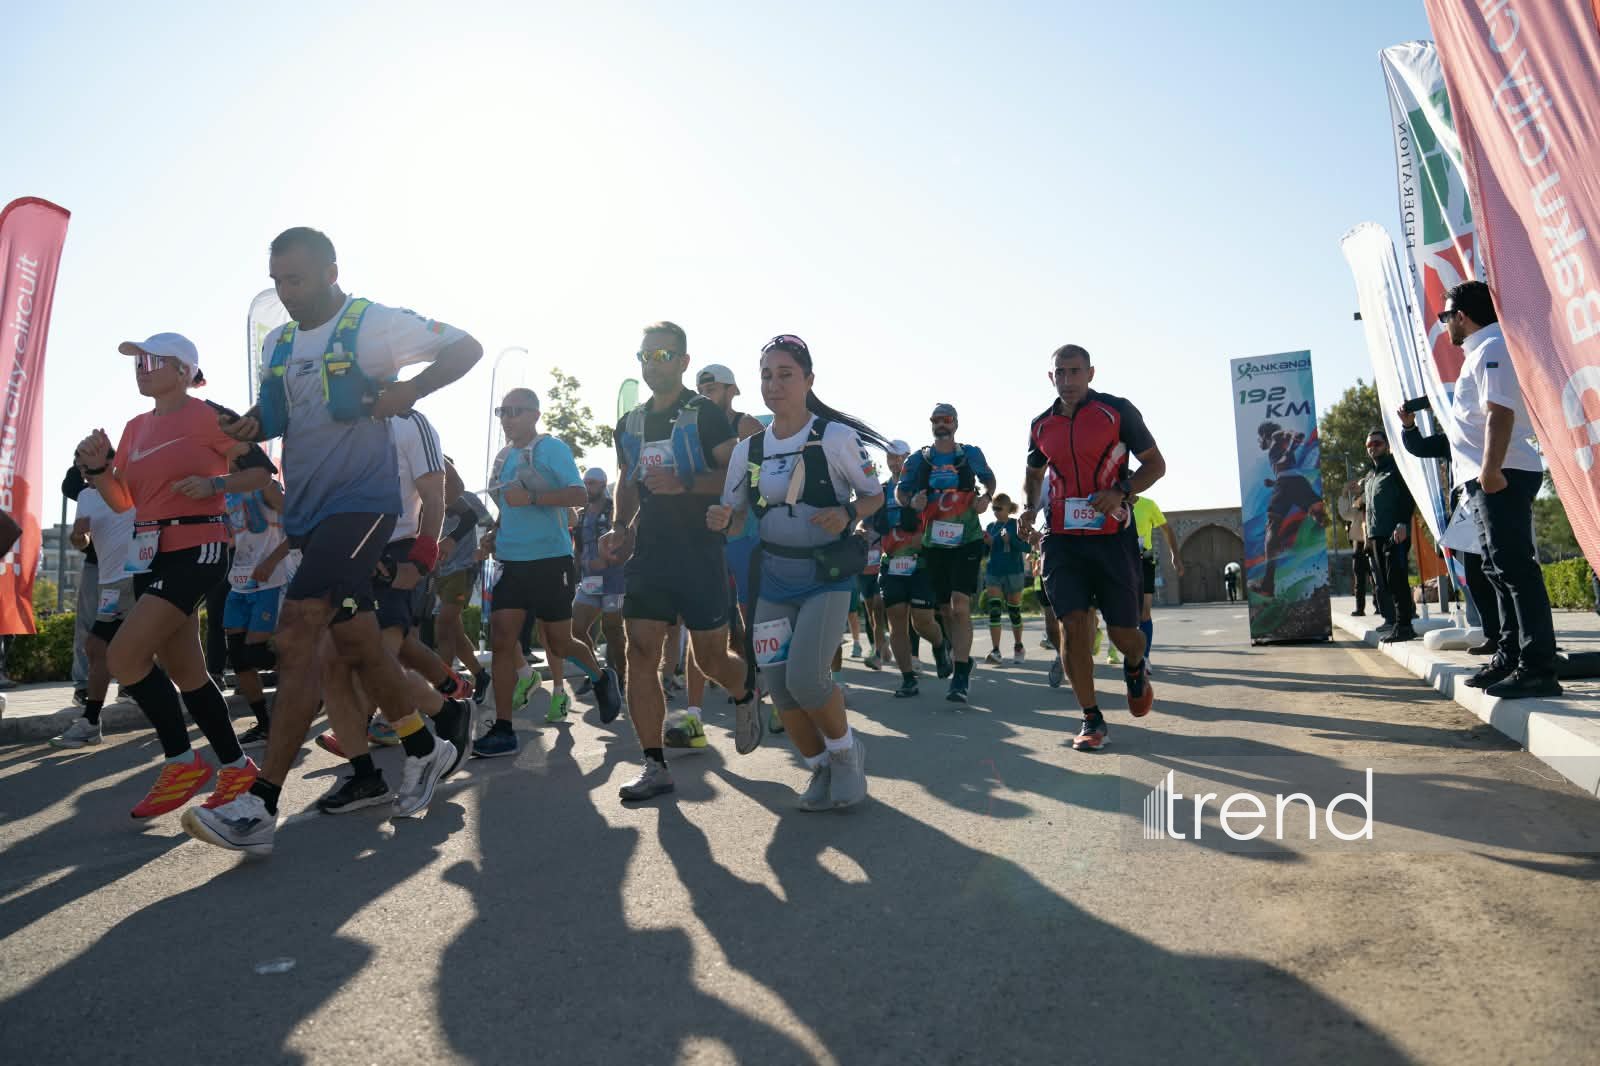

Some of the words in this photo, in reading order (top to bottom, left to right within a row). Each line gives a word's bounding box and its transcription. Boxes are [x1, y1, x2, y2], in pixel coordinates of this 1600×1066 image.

[9, 253, 39, 348] circuit
[5, 357, 28, 419] city
[1239, 386, 1286, 405] 192
[1265, 400, 1311, 419] KM
[0, 423, 18, 514] Baku
[1073, 508, 1096, 520] 053
[755, 637, 779, 655] 070
